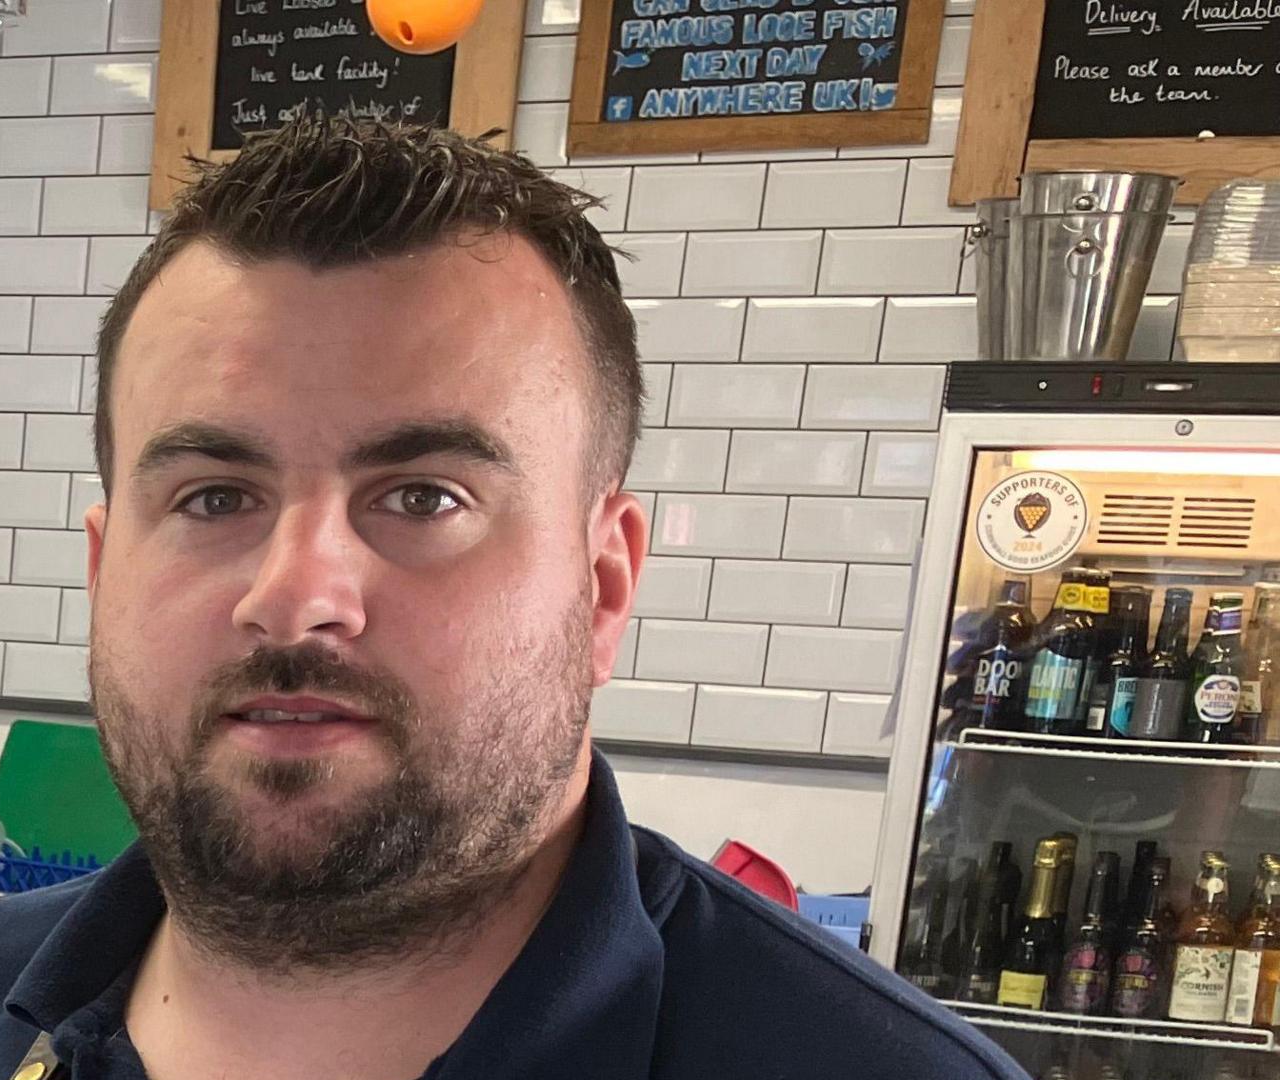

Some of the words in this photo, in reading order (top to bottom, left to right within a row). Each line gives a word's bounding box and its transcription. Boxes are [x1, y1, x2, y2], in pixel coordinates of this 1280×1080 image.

[232, 28, 284, 57] always
[294, 18, 359, 40] available
[620, 15, 734, 49] FAMOUS
[742, 10, 817, 44] LOOE
[822, 7, 898, 40] FISH
[251, 66, 277, 83] live
[681, 48, 763, 82] NEXT
[765, 44, 827, 78] DAY
[1054, 55, 1110, 80] Please
[1128, 58, 1159, 77] ask
[1167, 65, 1181, 77] a
[1195, 58, 1264, 78] member
[639, 80, 806, 118] ANYWHERE
[813, 77, 873, 112] UK!
[1109, 84, 1145, 104] the
[232, 97, 268, 126] Just
[991, 477, 1069, 507] SUPPORTERS
[1064, 494, 1080, 507] OF
[977, 659, 1022, 678] DOO
[973, 679, 1010, 697] BAR
